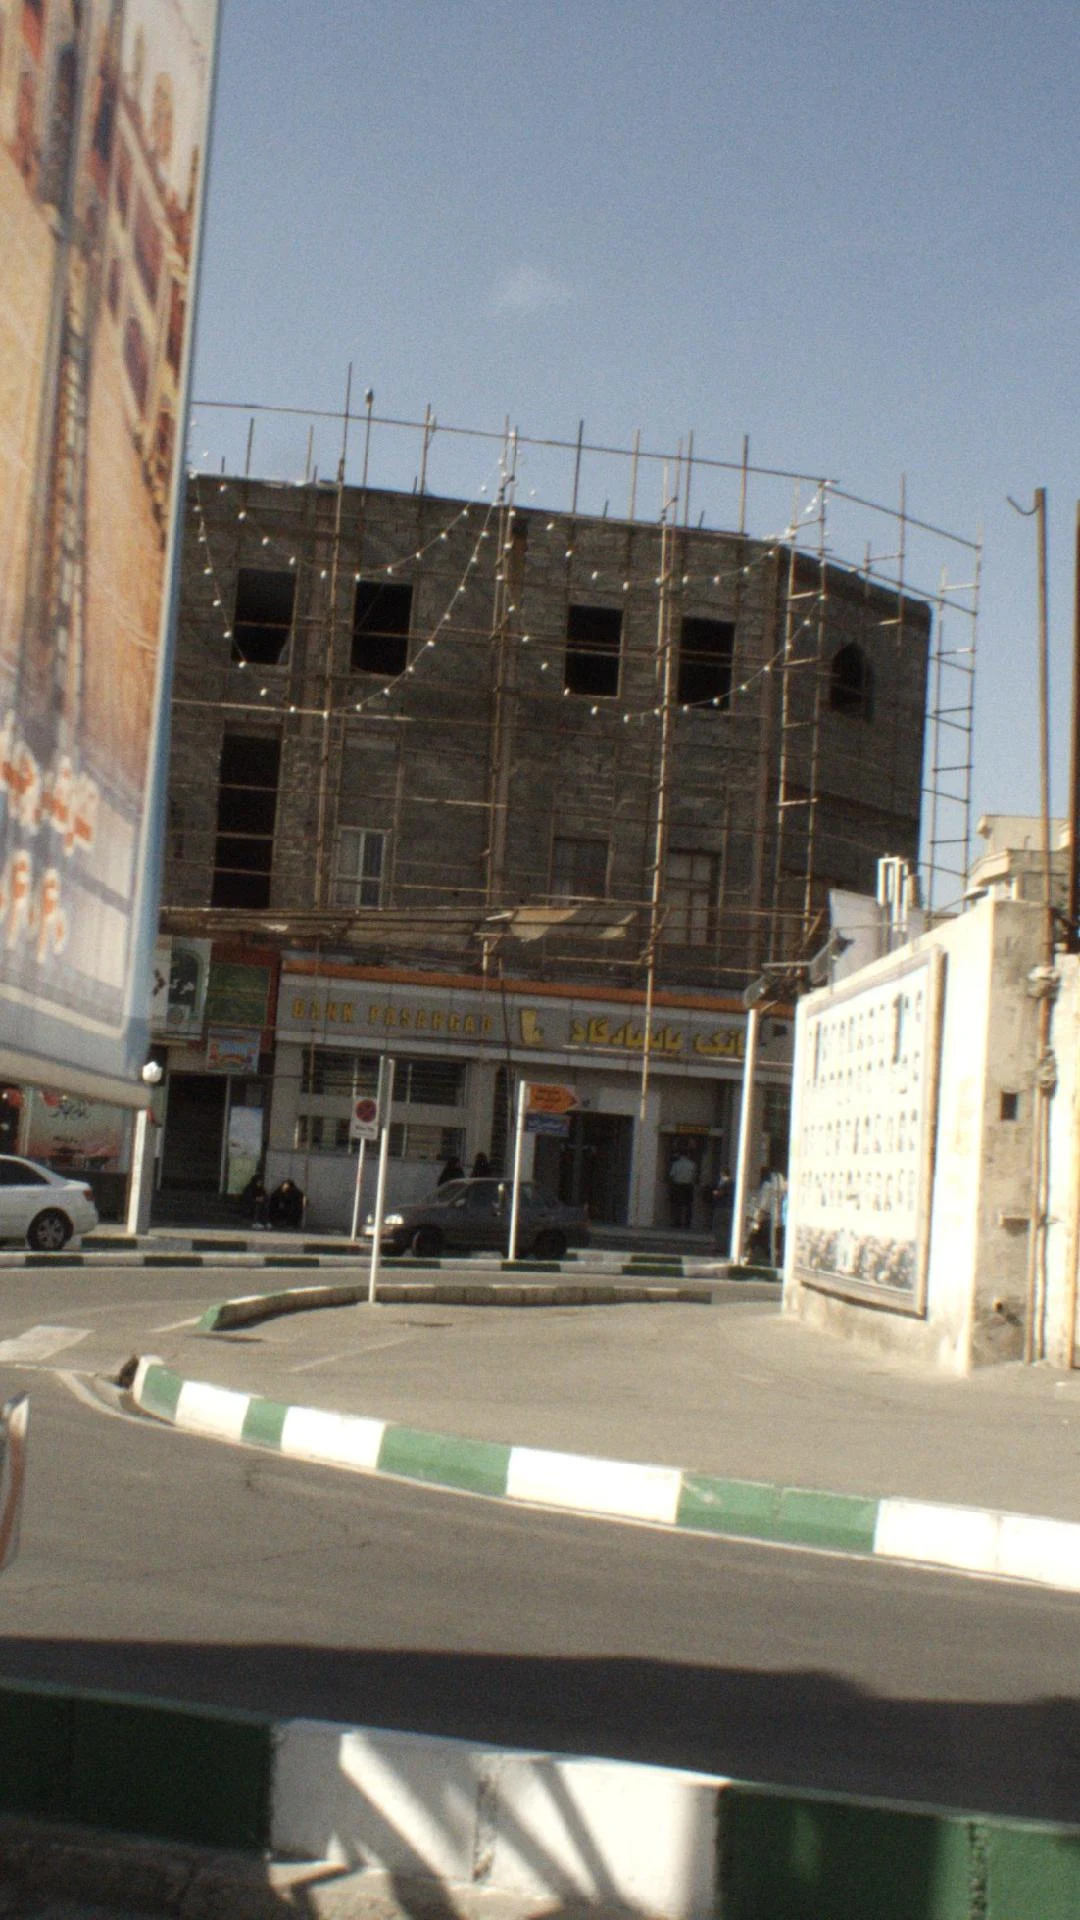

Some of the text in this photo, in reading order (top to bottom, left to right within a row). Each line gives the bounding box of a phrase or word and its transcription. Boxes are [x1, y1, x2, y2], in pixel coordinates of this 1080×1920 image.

[292, 997, 493, 1033] BANK PASARGAD
[692, 1027, 750, 1058] انک
